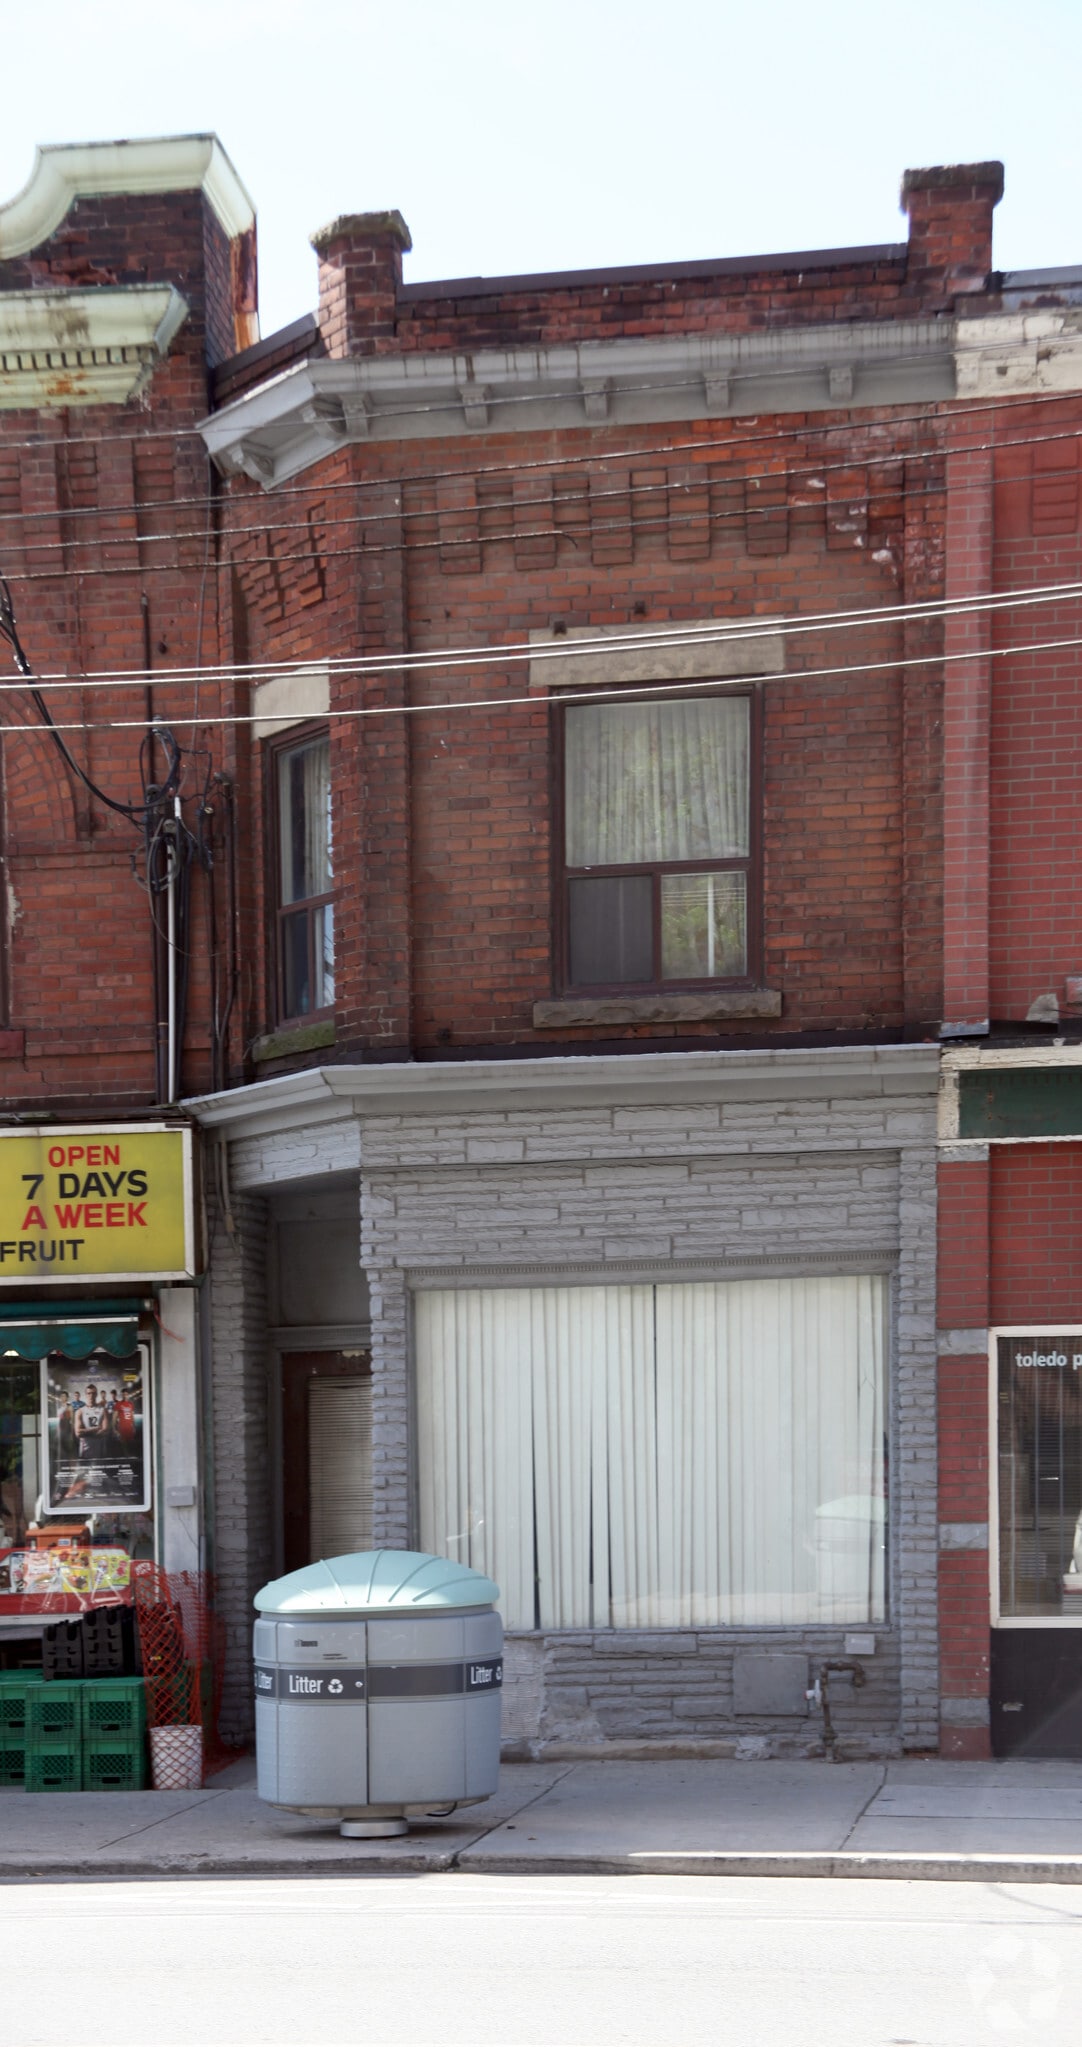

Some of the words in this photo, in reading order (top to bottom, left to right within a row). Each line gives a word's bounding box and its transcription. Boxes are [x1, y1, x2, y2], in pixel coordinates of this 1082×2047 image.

[48, 1145, 120, 1168] OPEN
[21, 1174, 45, 1200] 7
[58, 1170, 148, 1199] DAYS
[21, 1205, 48, 1230] A
[54, 1202, 148, 1229] WEEK
[0, 1239, 85, 1263] FRUIT
[1015, 1350, 1067, 1367] toledo
[257, 1670, 273, 1690] Litter
[289, 1674, 324, 1693] Litter
[470, 1666, 493, 1684] Litter
